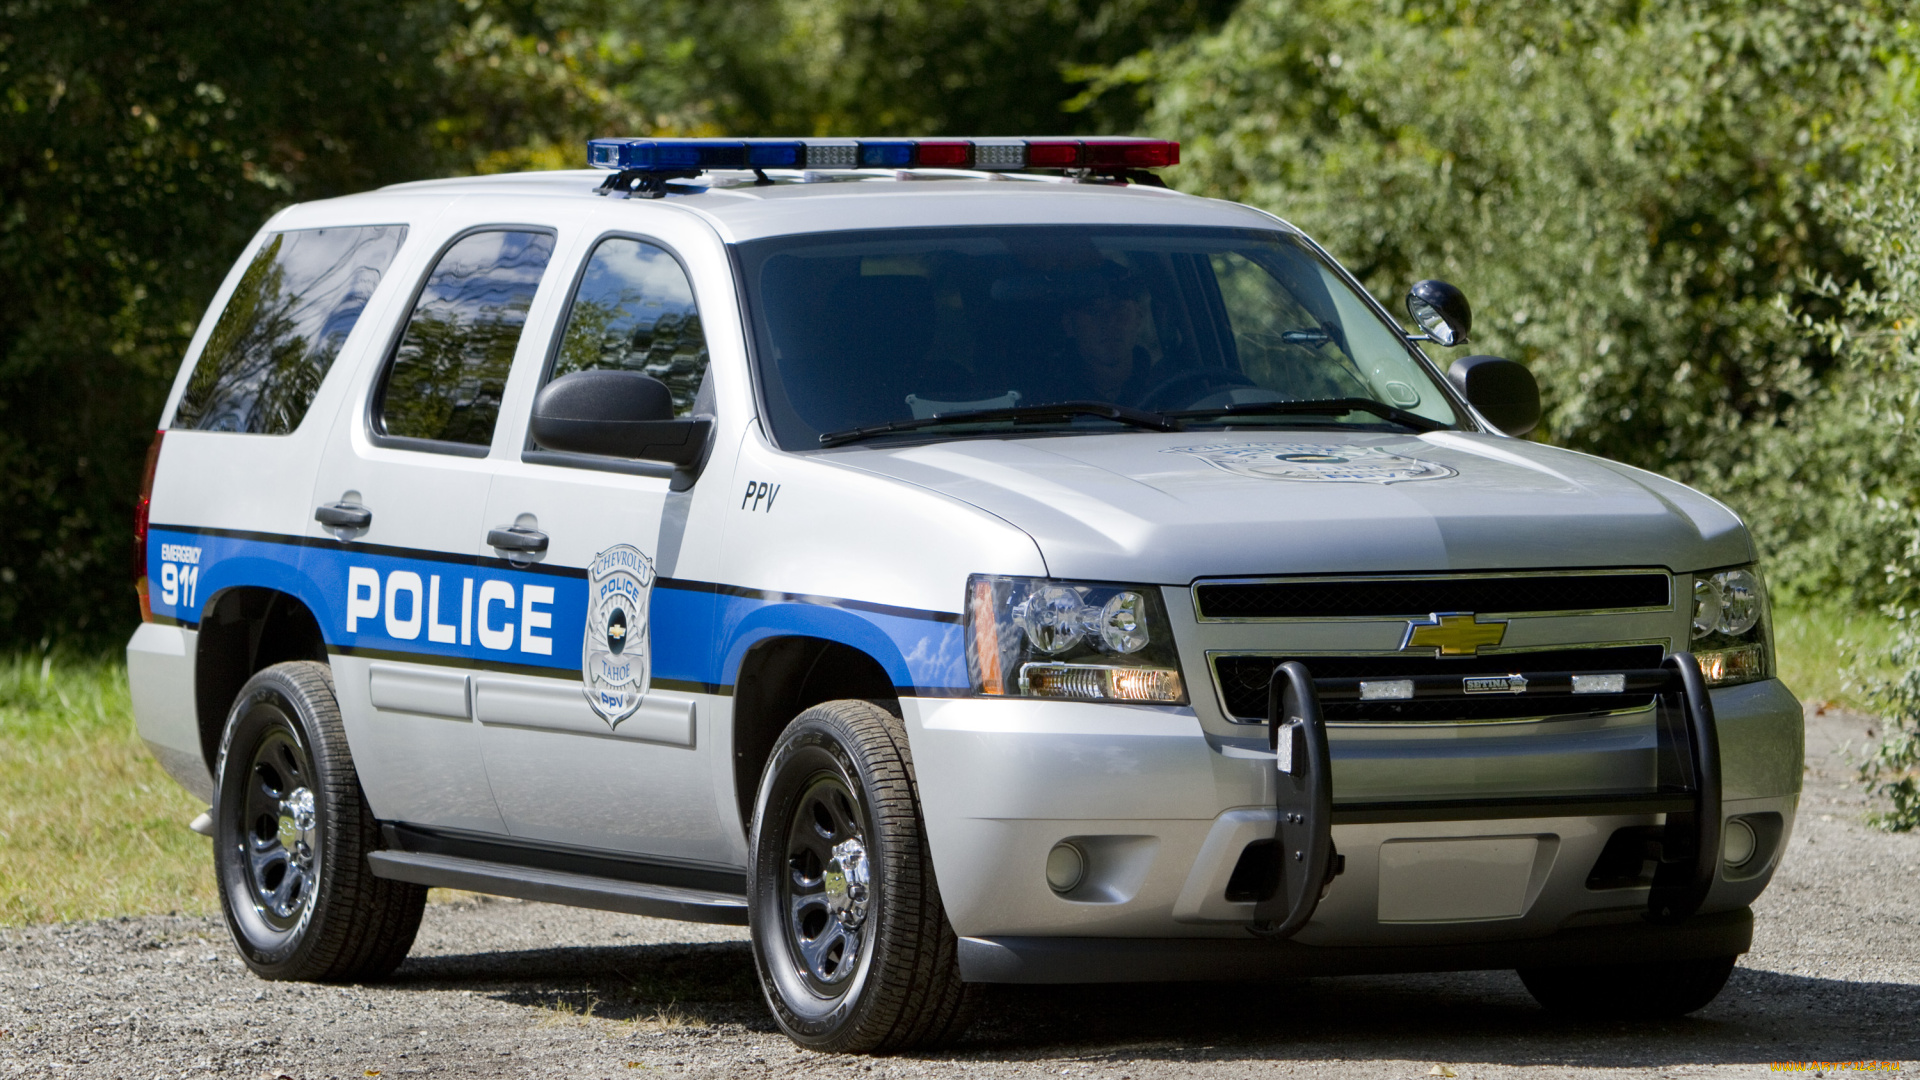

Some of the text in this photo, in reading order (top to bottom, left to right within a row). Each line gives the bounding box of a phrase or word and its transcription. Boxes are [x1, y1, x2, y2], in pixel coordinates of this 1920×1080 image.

[741, 480, 781, 513] PPV
[161, 543, 202, 564] EMERGENCY
[596, 550, 648, 580] CHEVROLET
[161, 562, 199, 608] 911
[600, 577, 639, 603] POLICE
[346, 566, 555, 656] POLICE
[601, 659, 631, 681] TAHOE
[1466, 679, 1509, 689] SETINA
[601, 691, 624, 709] PPV
